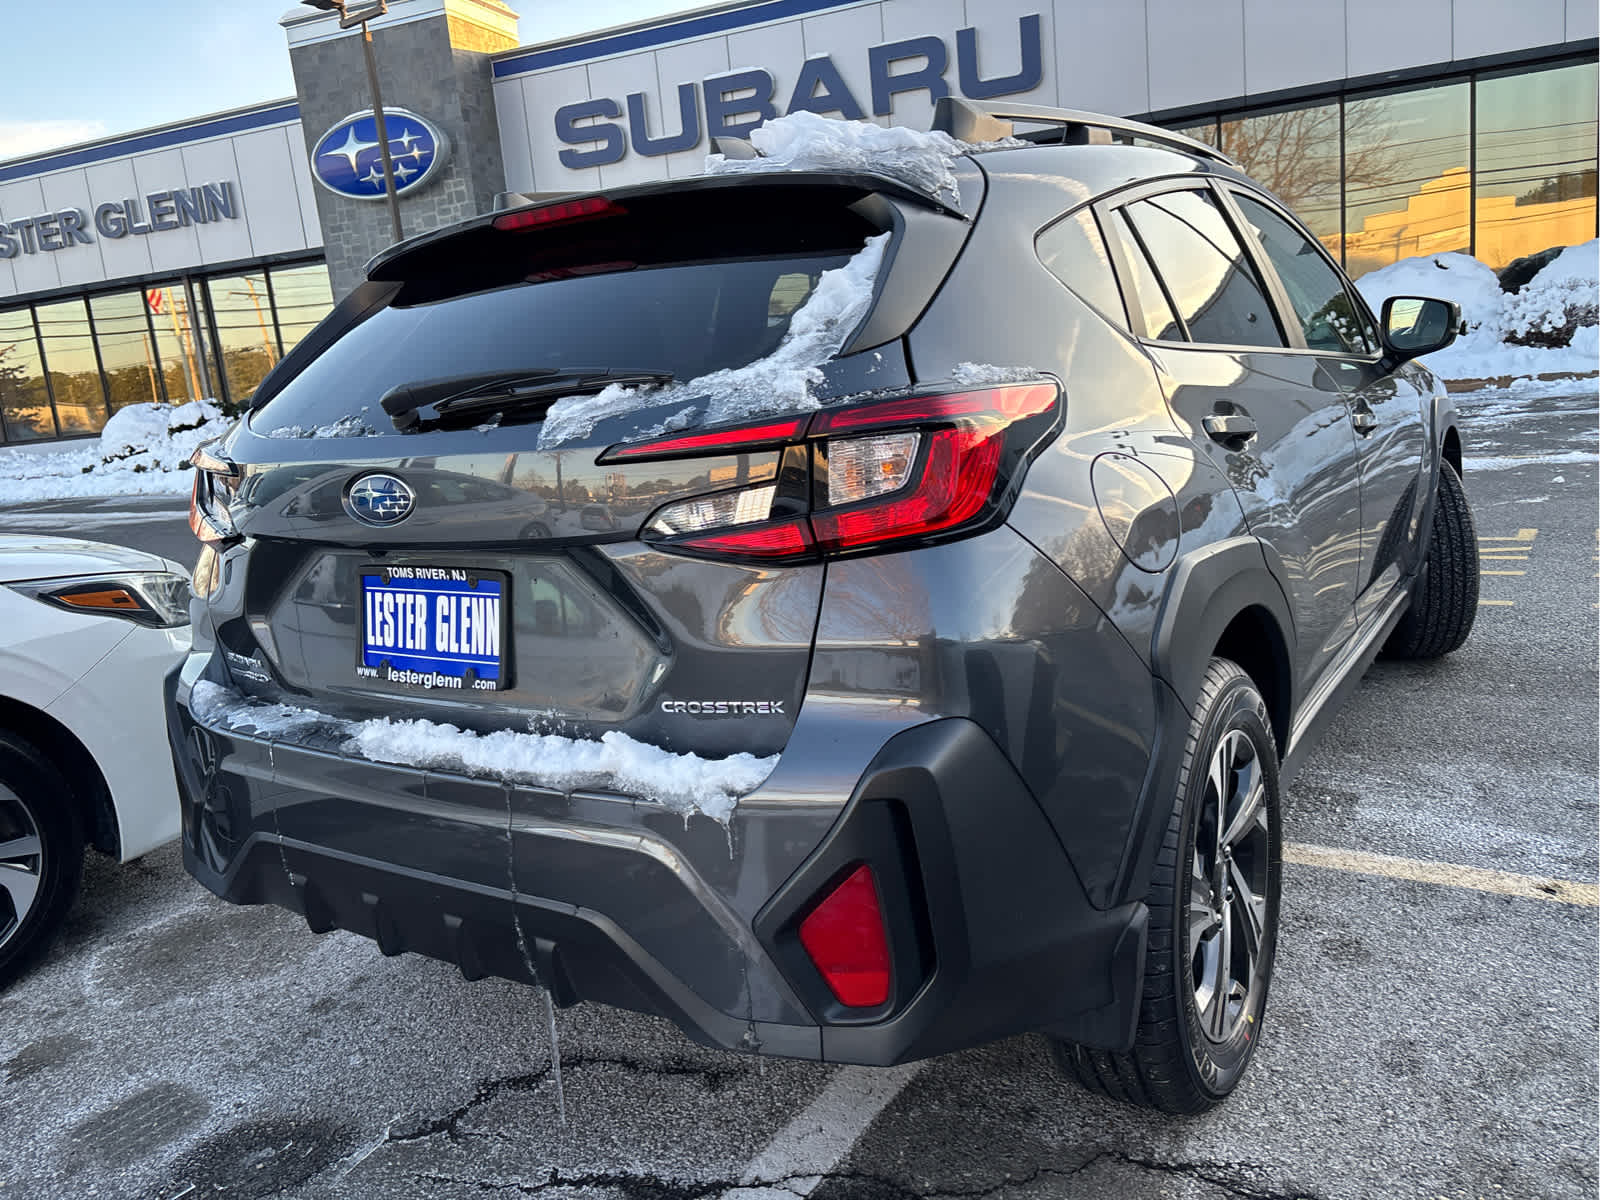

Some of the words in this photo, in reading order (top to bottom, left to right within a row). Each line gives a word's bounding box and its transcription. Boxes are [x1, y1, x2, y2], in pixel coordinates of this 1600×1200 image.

[555, 13, 1042, 170] SUBARU
[95, 180, 238, 239] GLENN
[387, 567, 414, 579] TOMS
[451, 570, 467, 582] NJ
[366, 591, 427, 651] LESTER
[435, 595, 500, 657] GLENN
[388, 667, 462, 689] lesterglenn
[661, 701, 785, 714] CROSSTREK
